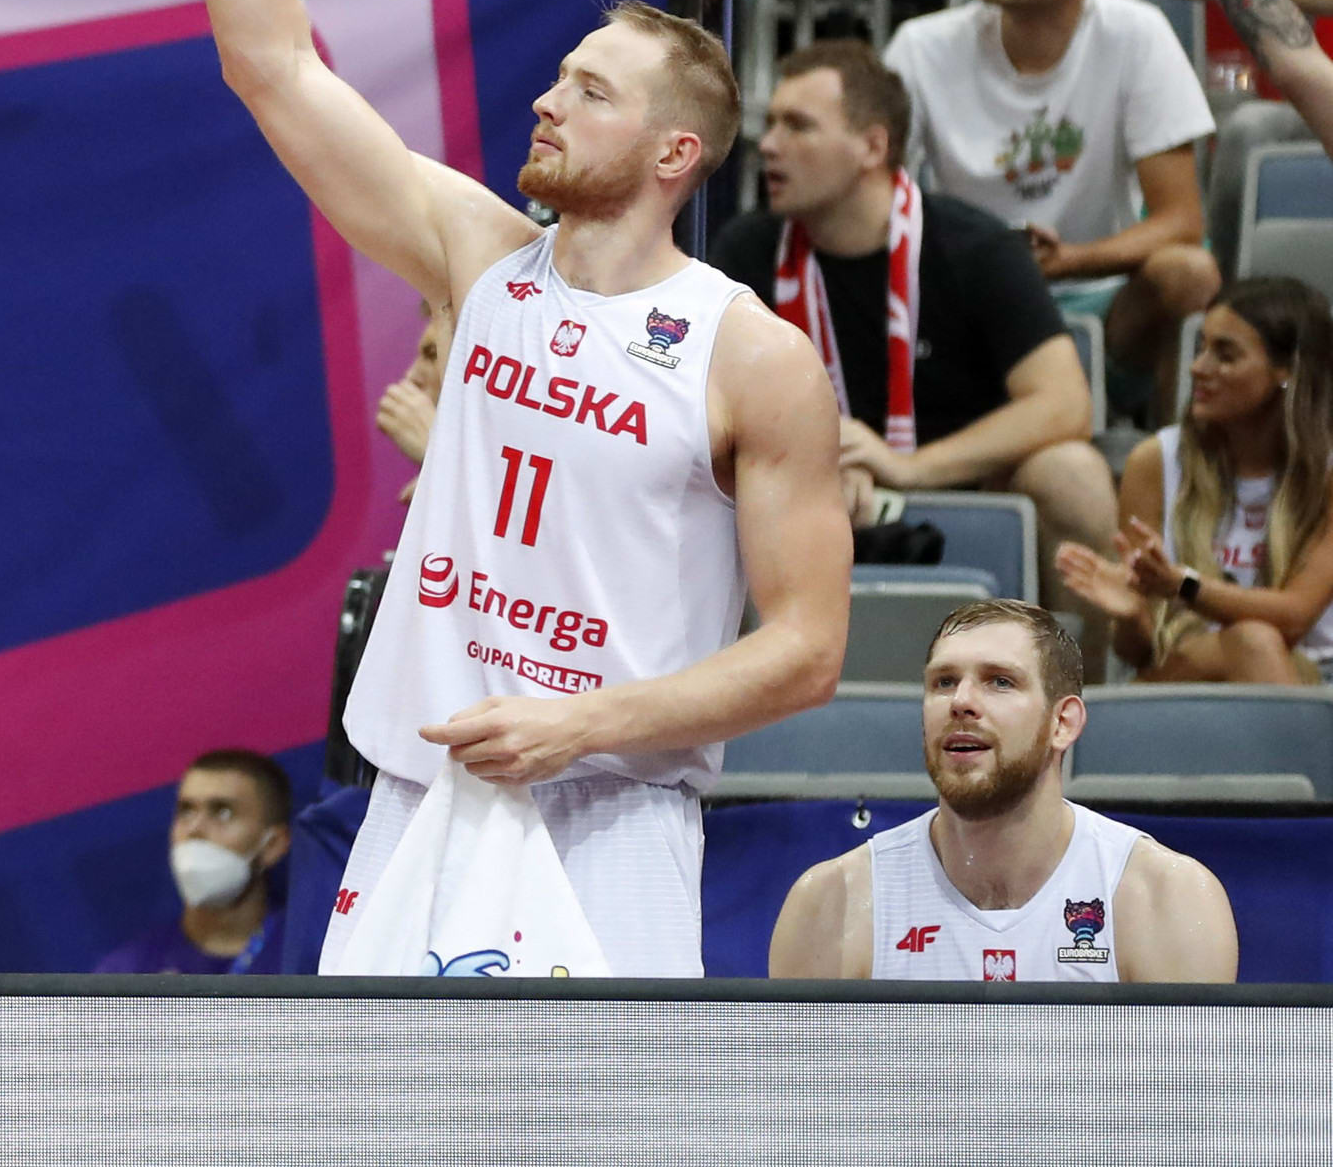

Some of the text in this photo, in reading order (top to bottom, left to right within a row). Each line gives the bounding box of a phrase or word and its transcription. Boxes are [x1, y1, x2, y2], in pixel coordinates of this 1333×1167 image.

[463, 344, 649, 446] POLSKA
[493, 444, 554, 548] 11
[468, 570, 610, 652] Energa
[522, 659, 597, 692] ORLEN
[895, 925, 942, 953] 4F
